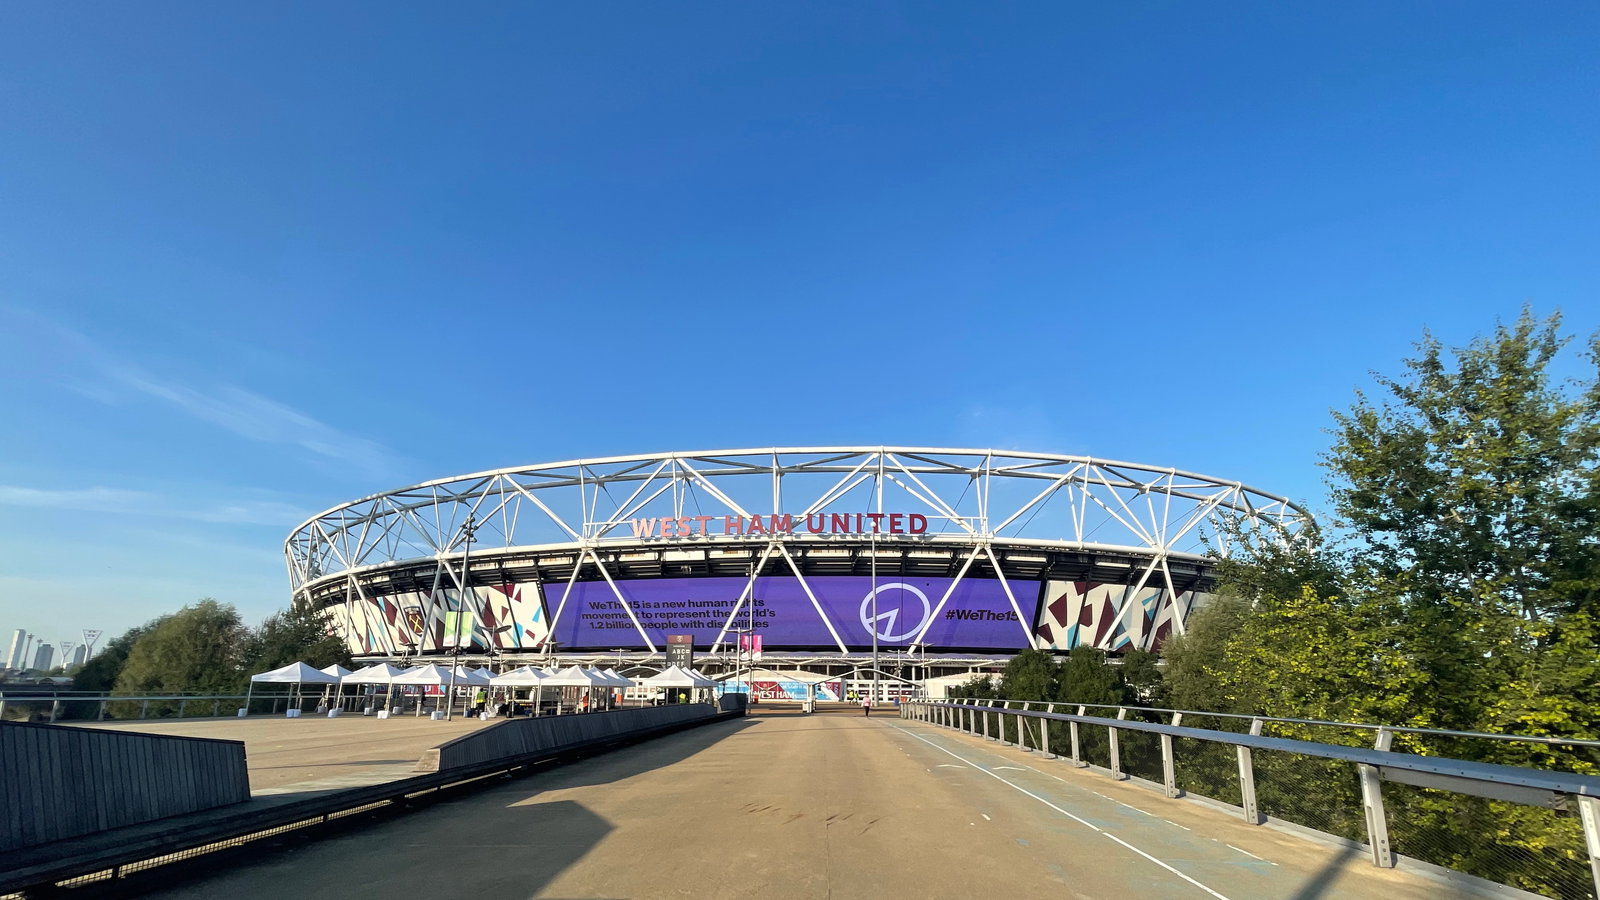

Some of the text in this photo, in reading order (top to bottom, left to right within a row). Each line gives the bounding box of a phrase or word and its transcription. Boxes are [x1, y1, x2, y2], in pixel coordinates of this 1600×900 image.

[631, 512, 928, 537] WEST HAM UNITED
[589, 600, 640, 609] WeTh15
[642, 600, 652, 609] is
[662, 601, 686, 609] new
[687, 599, 728, 608] human
[581, 611, 639, 619] movemet
[641, 610, 653, 619] to
[654, 609, 711, 620] represent
[712, 609, 732, 618] the
[945, 609, 1021, 621] #WeThe15
[590, 621, 604, 629] 1.2
[680, 620, 704, 629] with
